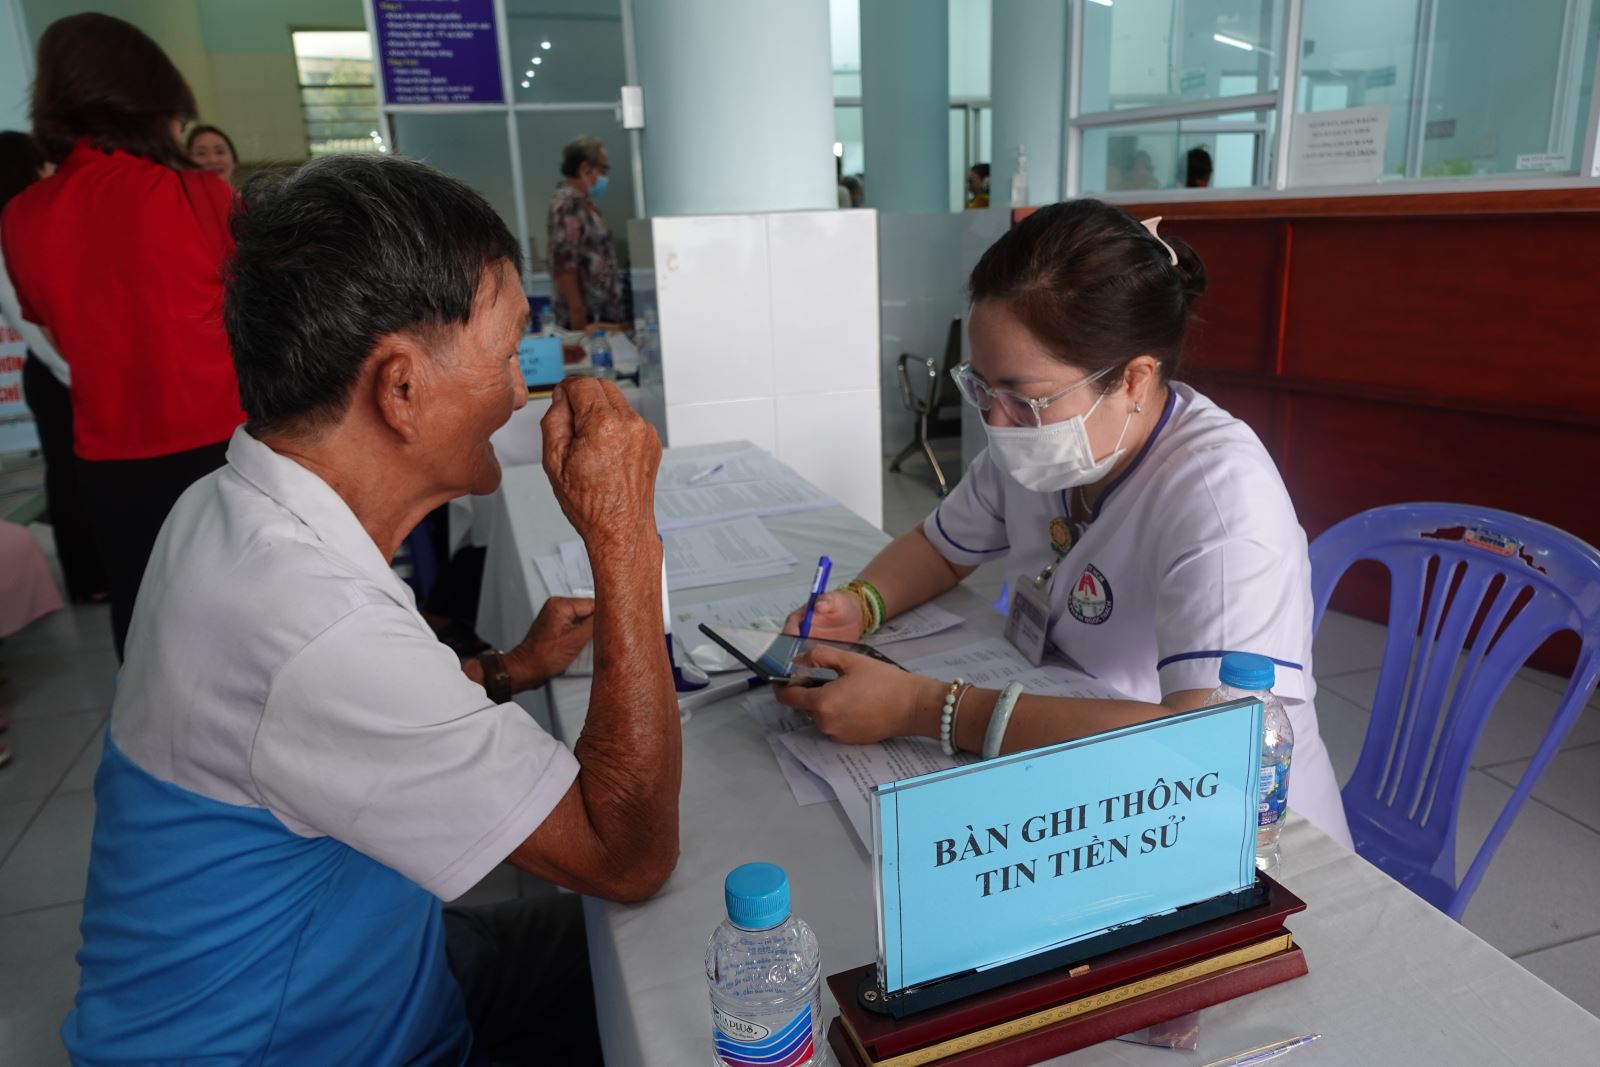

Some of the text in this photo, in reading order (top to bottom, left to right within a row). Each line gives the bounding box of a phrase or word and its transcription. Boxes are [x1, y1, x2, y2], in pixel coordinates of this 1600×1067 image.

[933, 823, 1010, 868] BÀN
[1021, 804, 1088, 843] GHI
[1098, 771, 1220, 825] THÔNG
[975, 814, 1186, 898] TIN TIỀN SỬ
